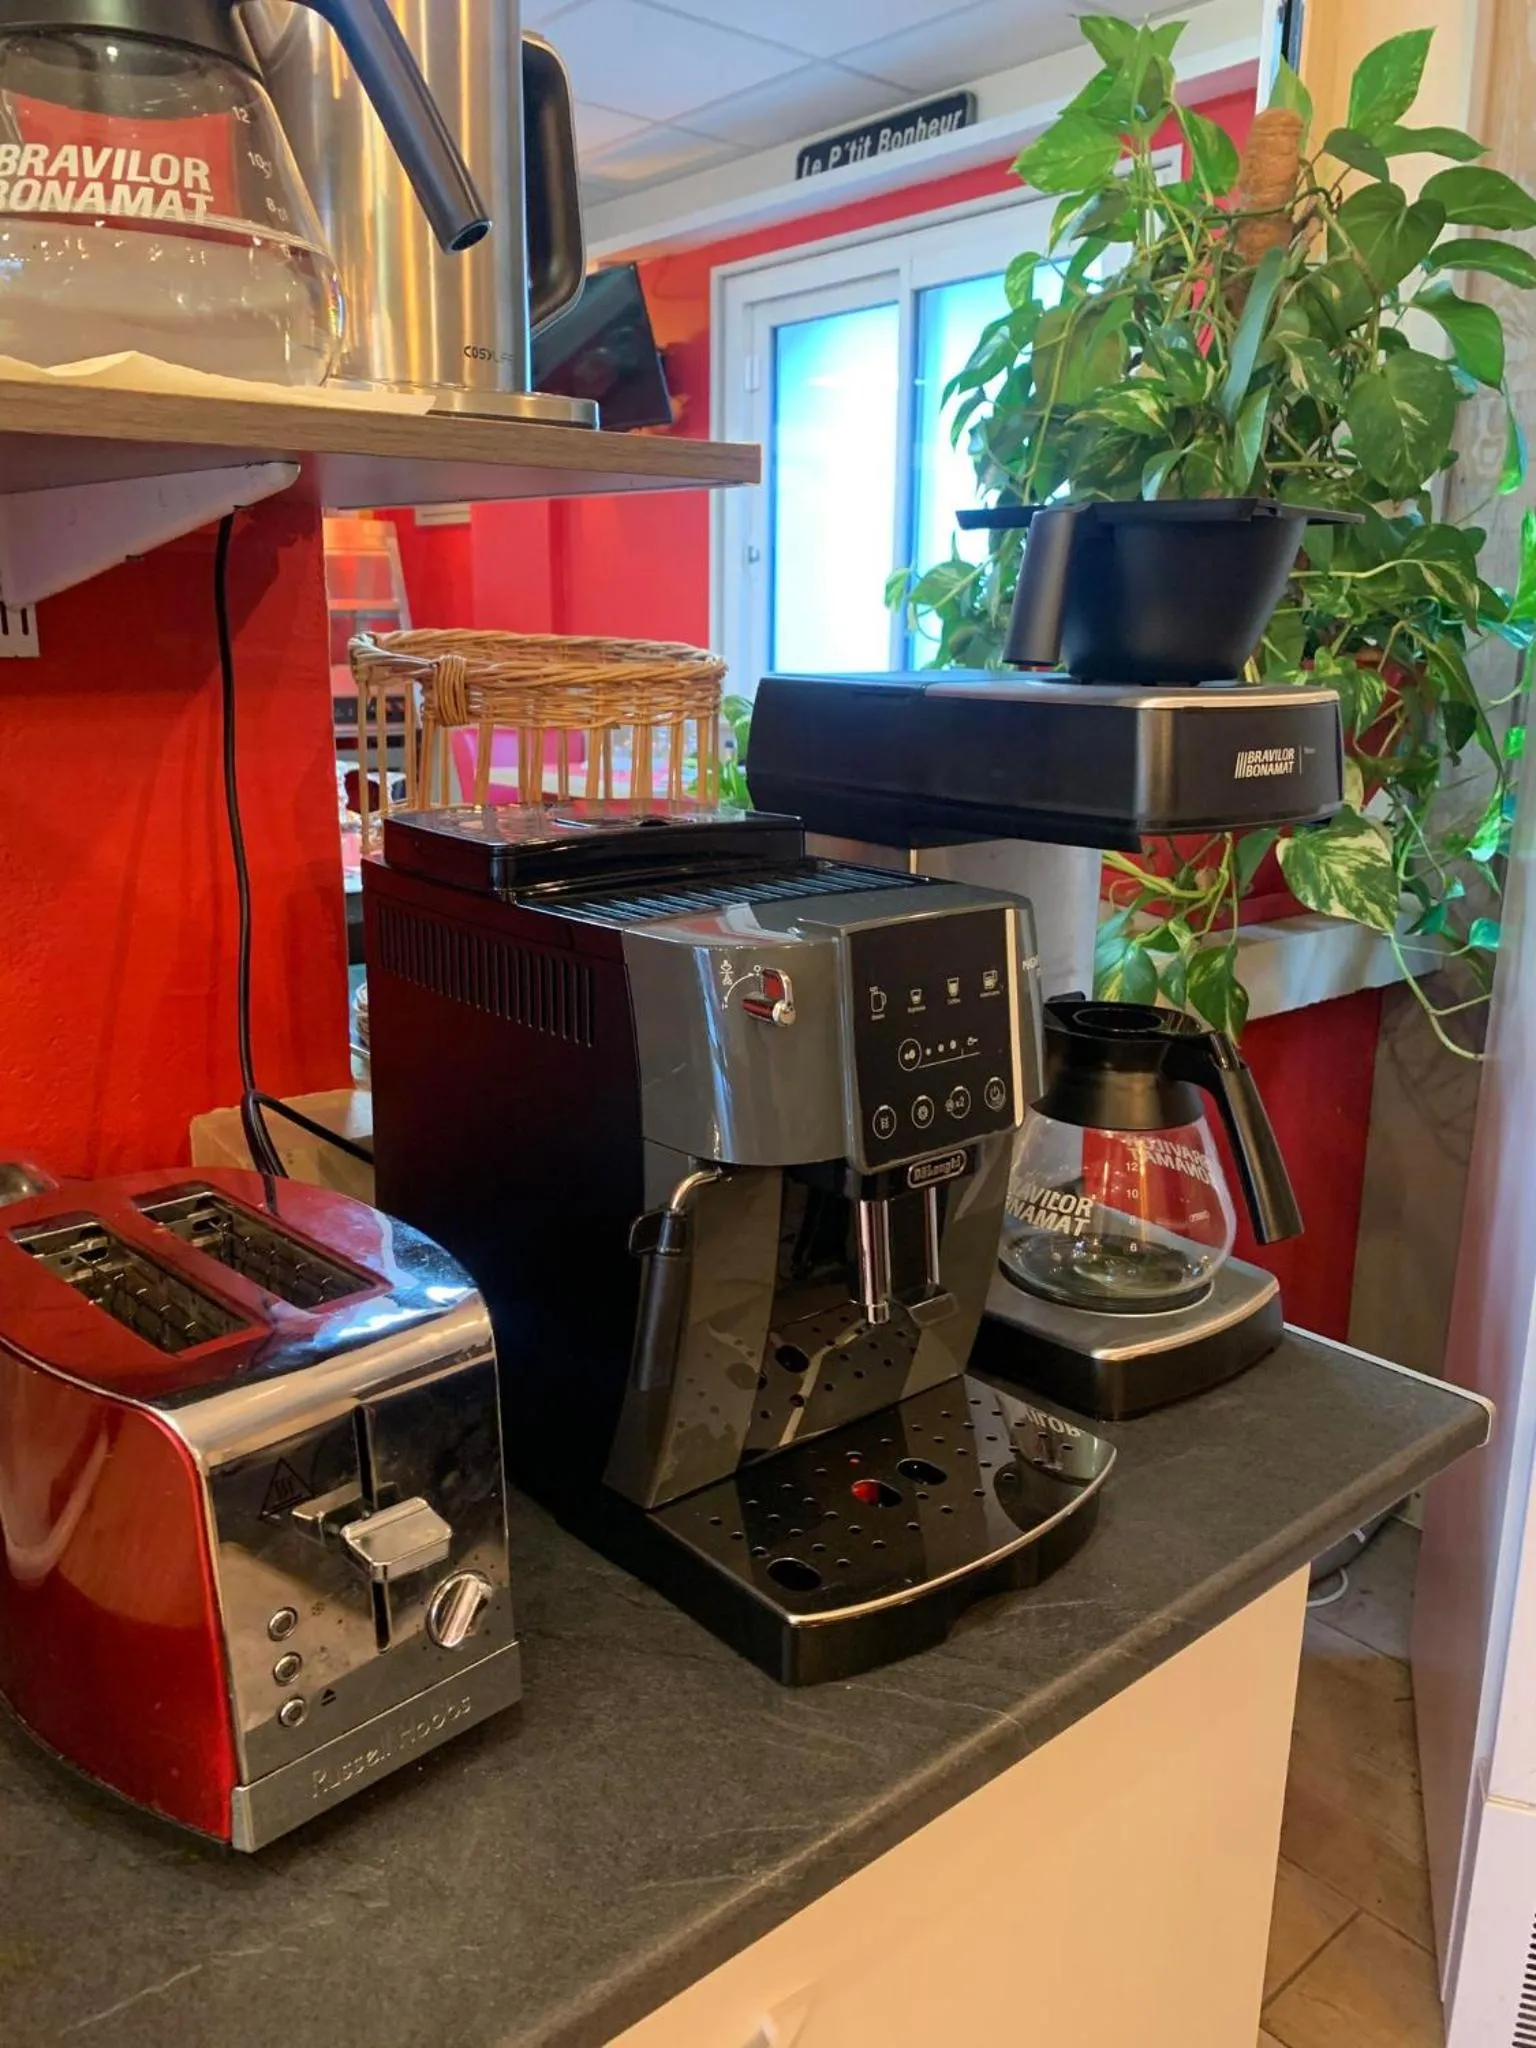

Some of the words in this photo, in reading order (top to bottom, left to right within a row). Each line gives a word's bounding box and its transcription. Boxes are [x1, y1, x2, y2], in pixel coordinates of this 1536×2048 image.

[876, 108, 963, 154] Bonheur
[0, 143, 211, 193] BRAVILOR
[1247, 747, 1295, 763] BRAVILOR
[1245, 761, 1295, 778] BONAMAT
[1125, 1161, 1138, 1172] 12
[1126, 1188, 1139, 1199] 10
